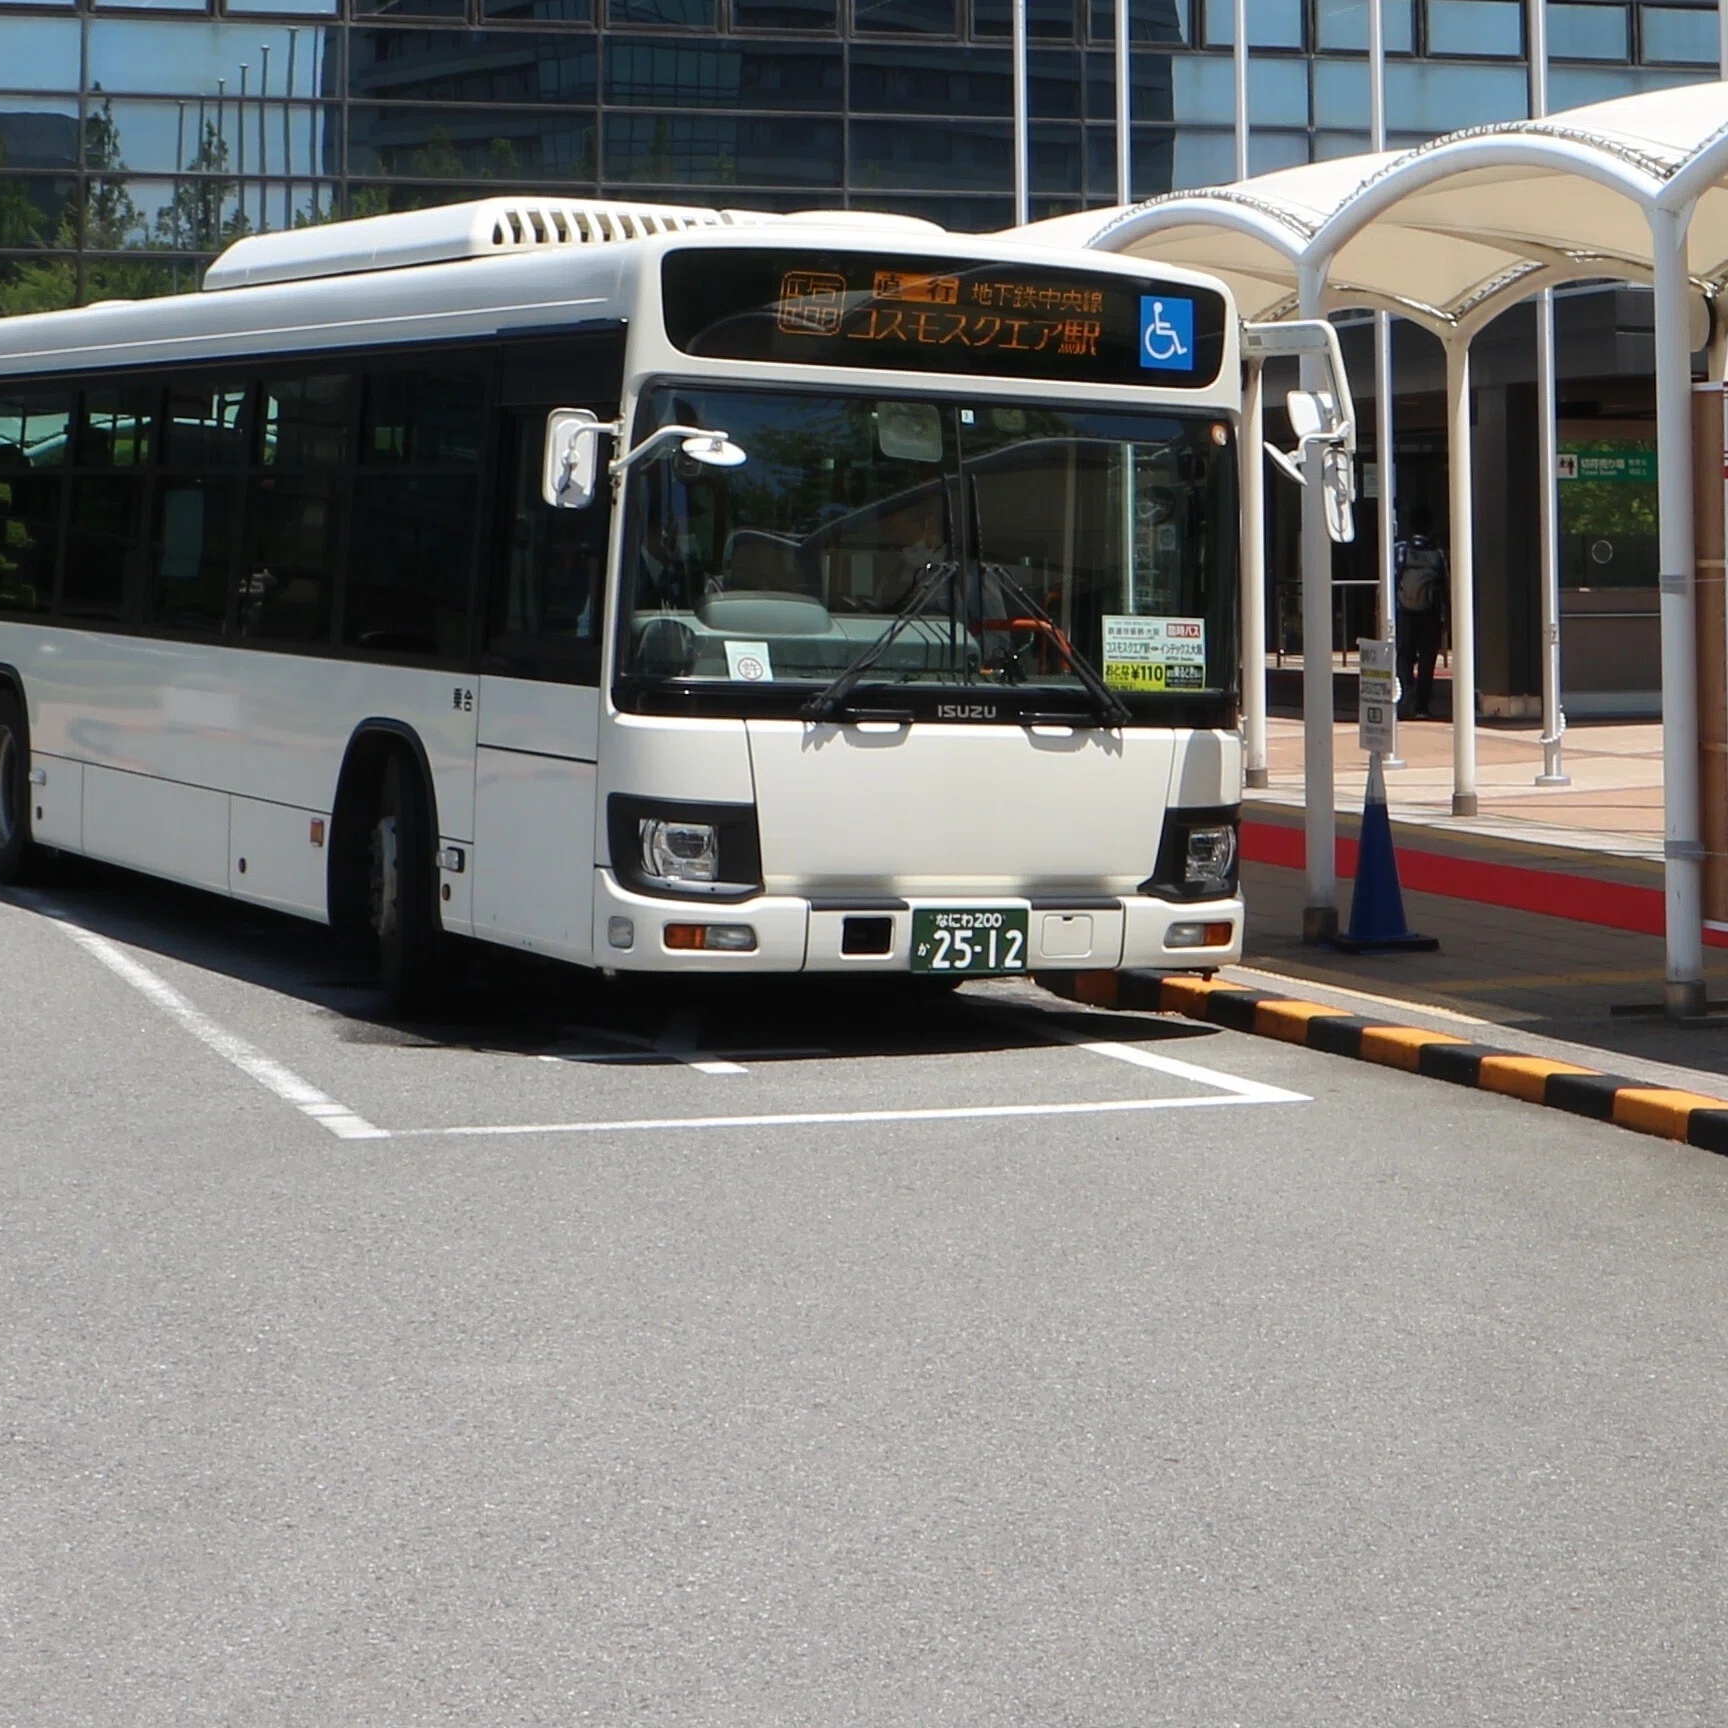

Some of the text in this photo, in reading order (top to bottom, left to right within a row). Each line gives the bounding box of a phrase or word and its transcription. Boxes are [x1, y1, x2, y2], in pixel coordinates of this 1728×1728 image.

[783, 276, 841, 332] 臨
[875, 273, 959, 303] 直行
[971, 282, 1104, 313] 地下鉄中央線
[847, 307, 1100, 356] コスモスクエア駅
[938, 705, 997, 718] ISUZU
[917, 930, 1023, 969] か 25-12
